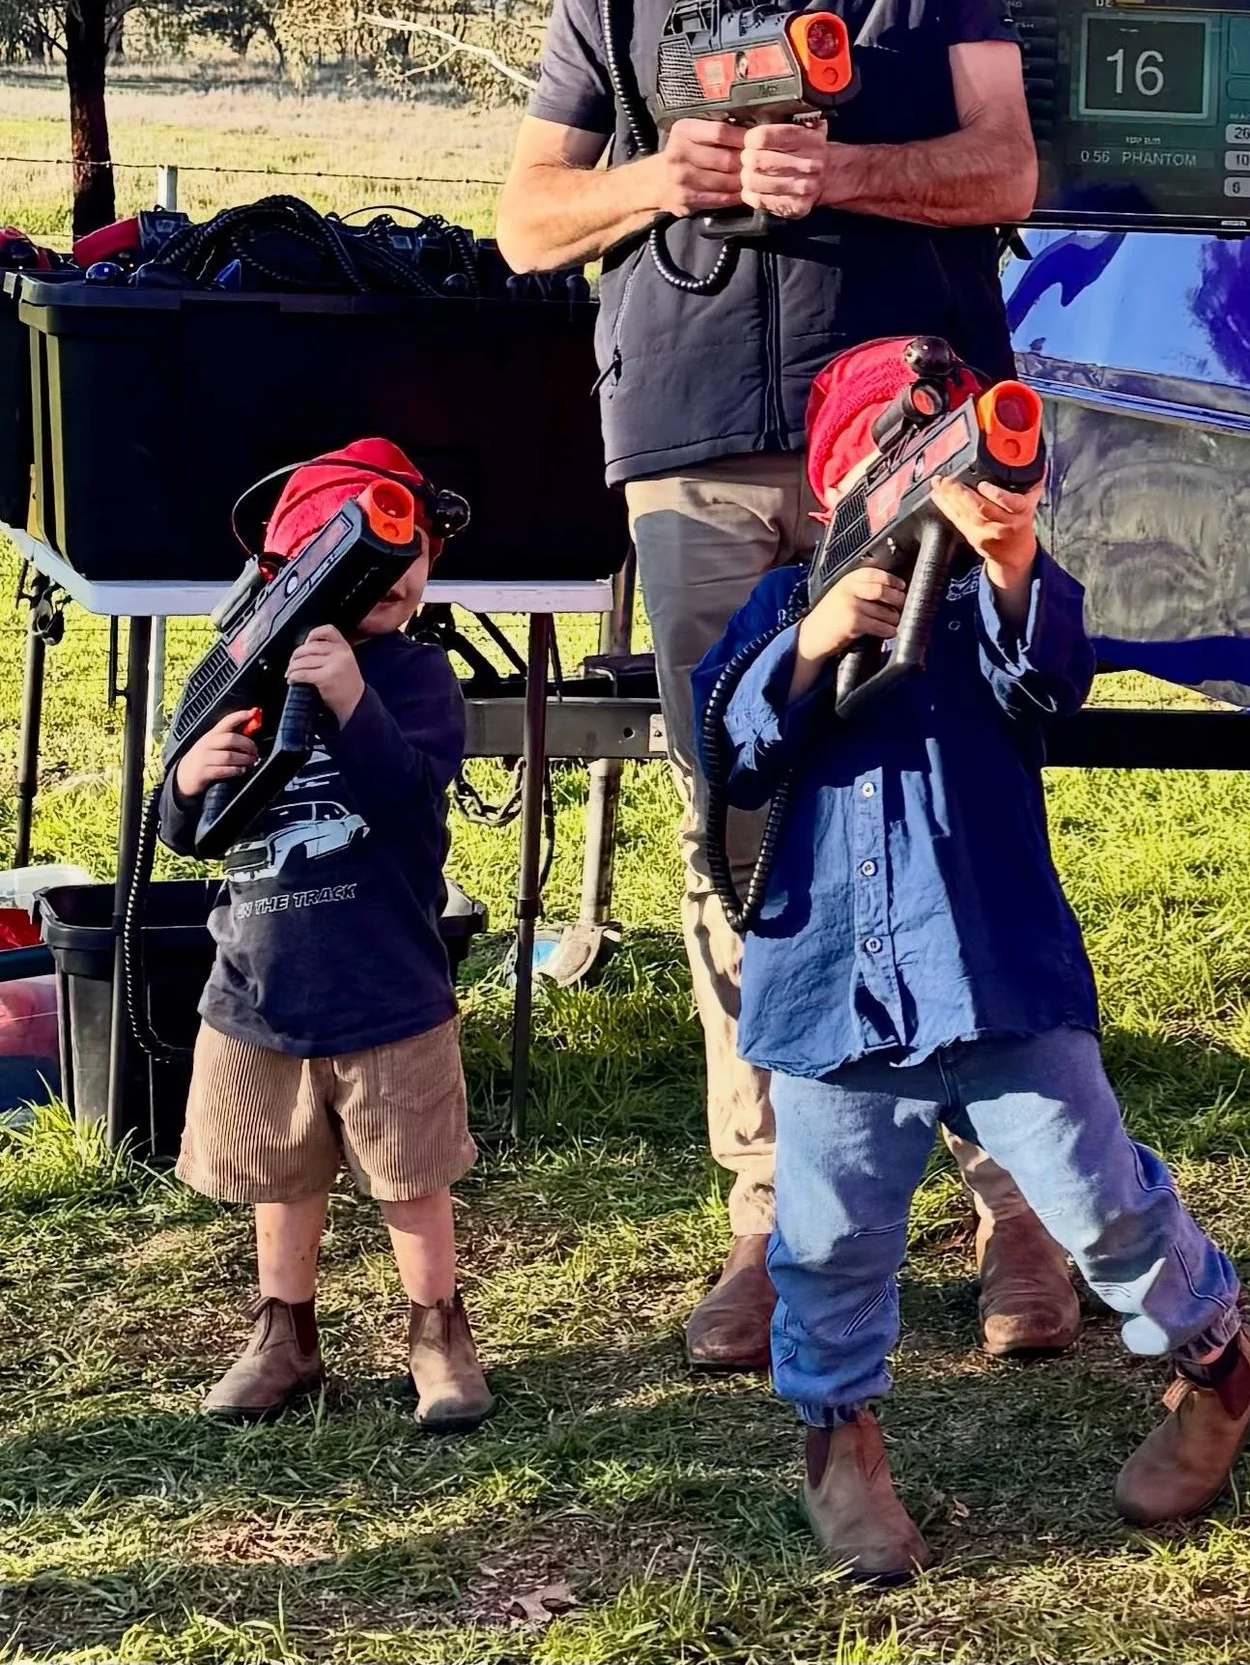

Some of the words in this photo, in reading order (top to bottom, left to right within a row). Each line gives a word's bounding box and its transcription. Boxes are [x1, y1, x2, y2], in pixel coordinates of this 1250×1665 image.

[1106, 48, 1164, 96] 16
[1233, 126, 1250, 140] 26
[1121, 151, 1197, 167] PHANTOM
[1235, 154, 1250, 167] 10
[255, 894, 290, 915] THE
[293, 882, 358, 908] TRACK
